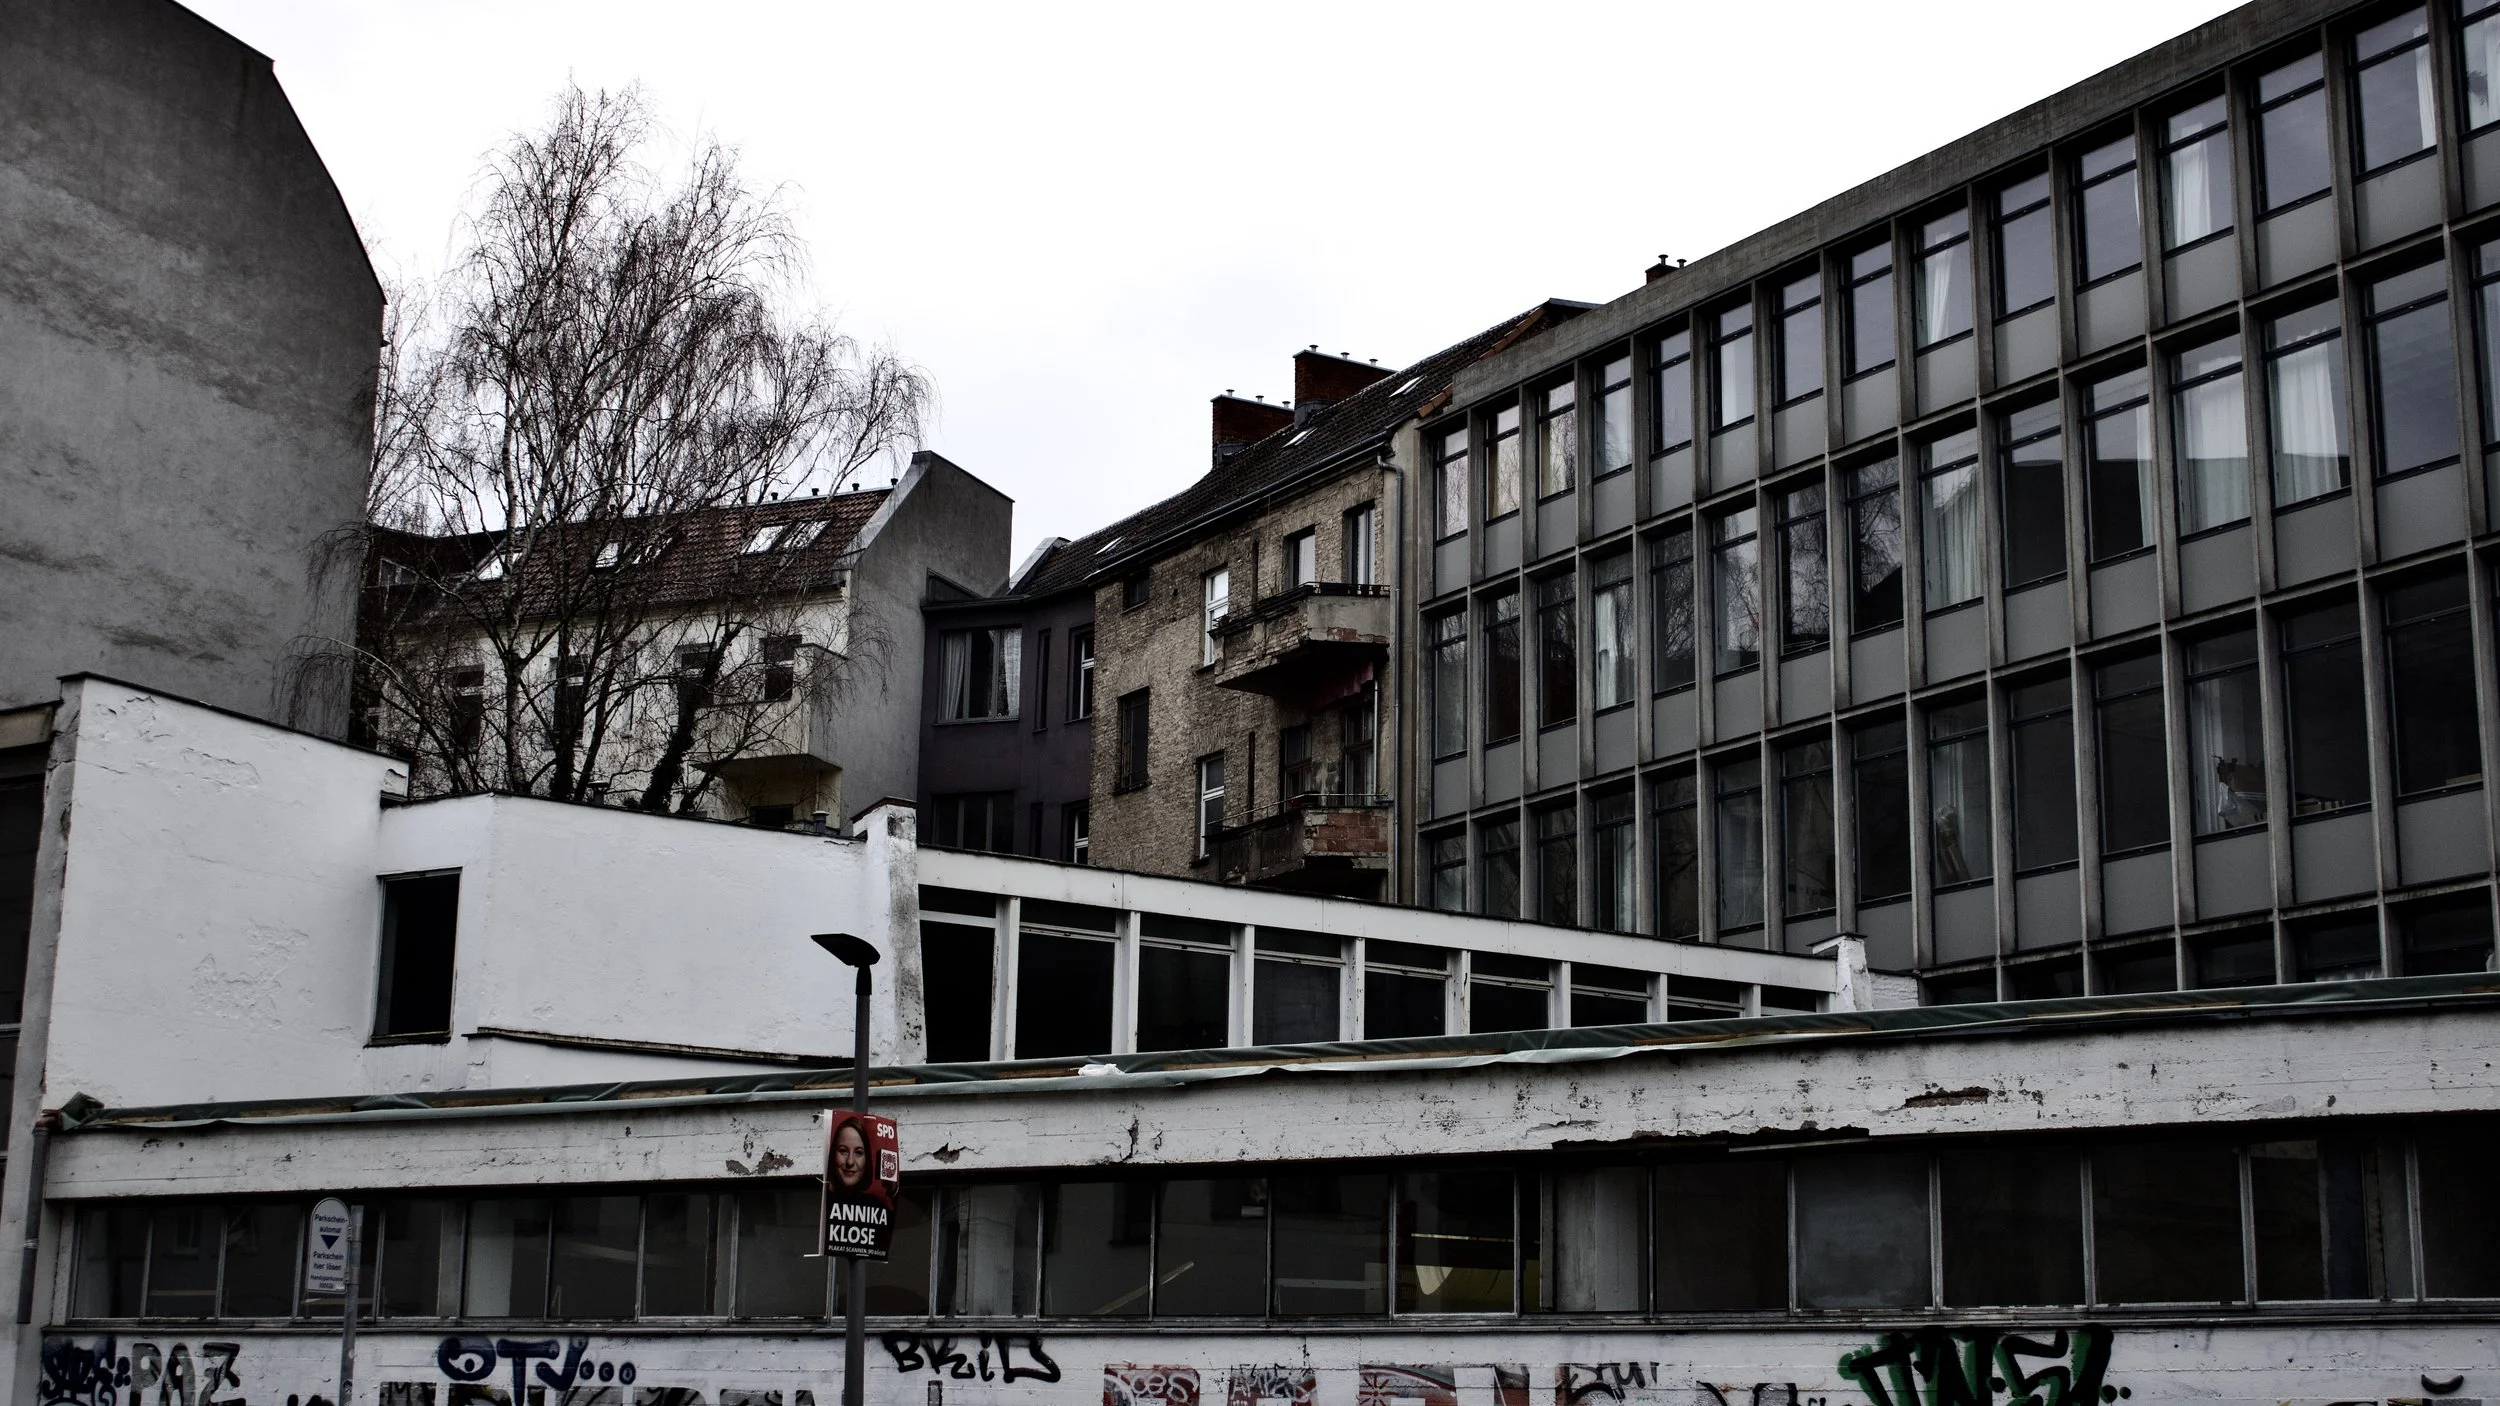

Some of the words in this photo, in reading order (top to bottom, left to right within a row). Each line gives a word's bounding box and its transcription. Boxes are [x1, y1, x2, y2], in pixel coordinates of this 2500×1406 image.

[876, 1122, 895, 1140] SPD
[883, 1161, 895, 1170] SPD
[314, 1213, 348, 1224] Parkschein-
[829, 1202, 888, 1226] ANNIKA
[829, 1224, 876, 1246] KLOSE
[313, 1250, 344, 1260] Parkschein
[313, 1262, 325, 1270] hier
